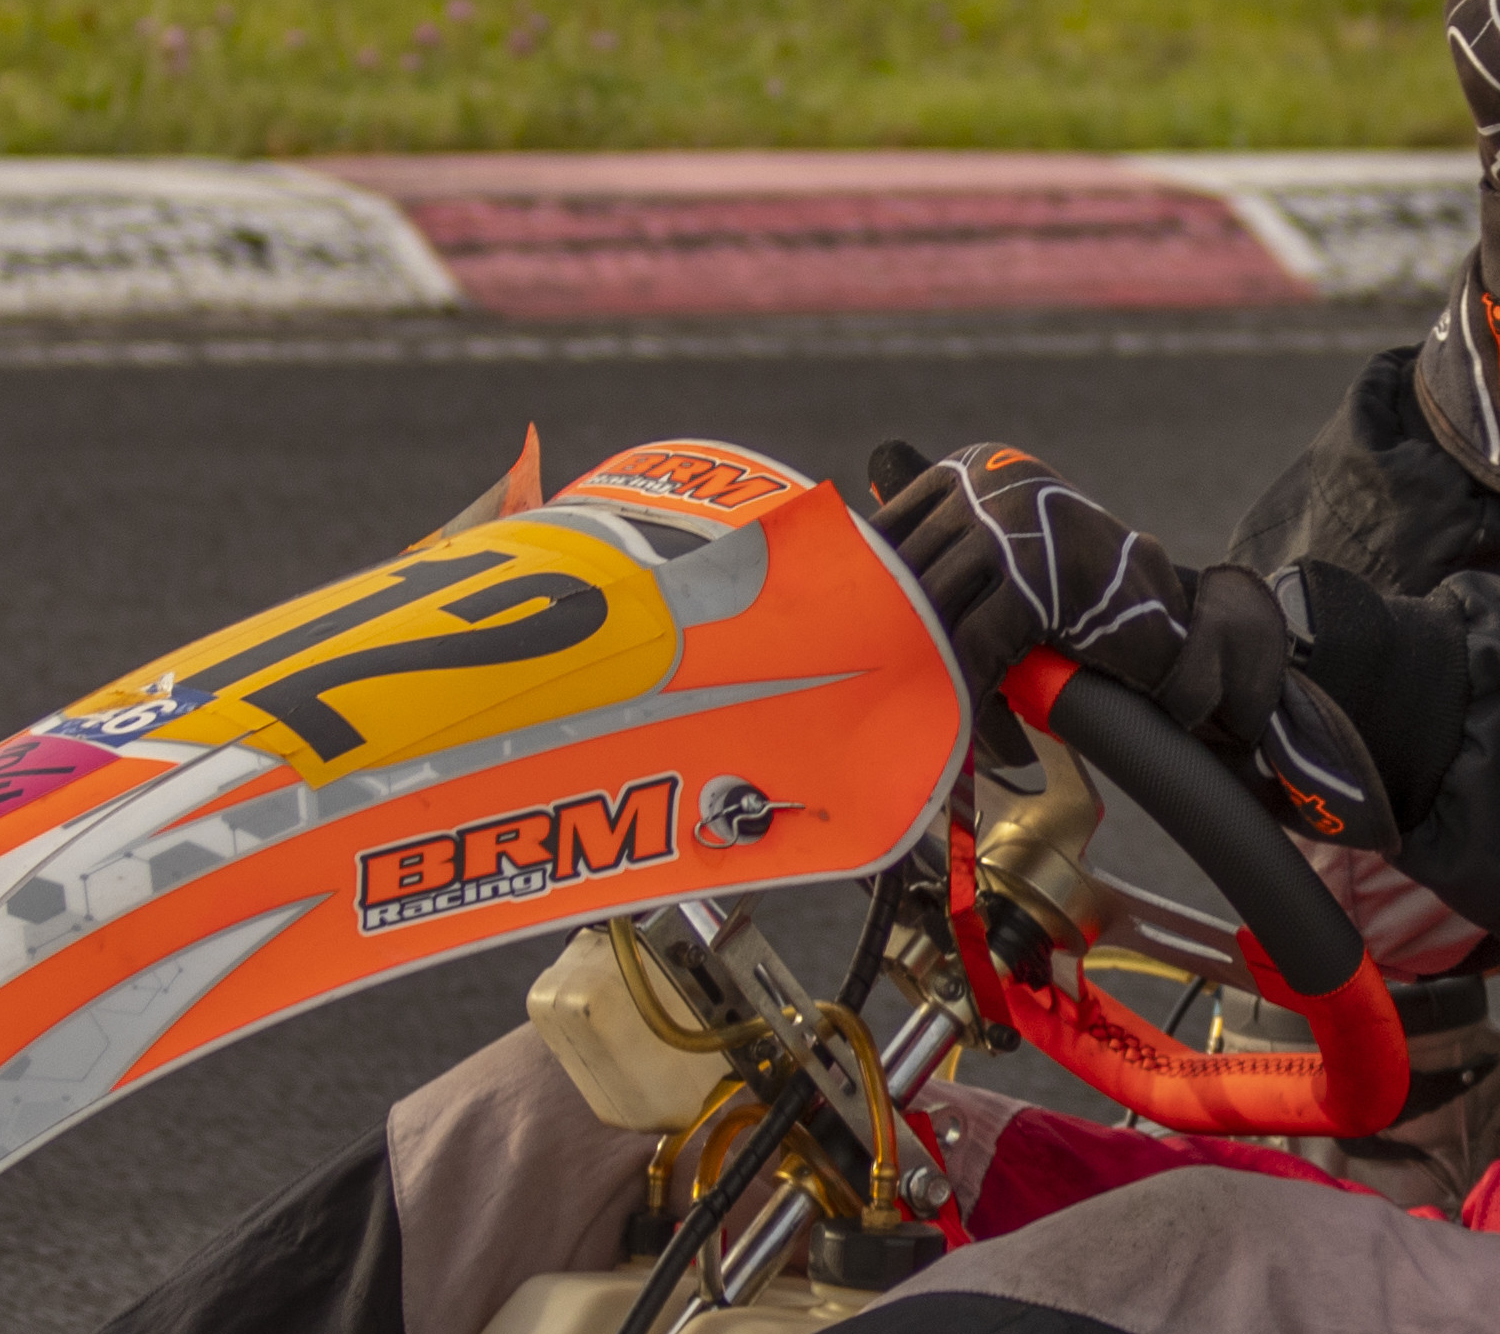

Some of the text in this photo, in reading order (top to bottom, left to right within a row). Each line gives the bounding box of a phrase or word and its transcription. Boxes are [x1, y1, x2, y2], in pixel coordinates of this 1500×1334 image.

[598, 452, 788, 508] BRM
[360, 774, 681, 907] BRM
[363, 870, 547, 932] Racing
